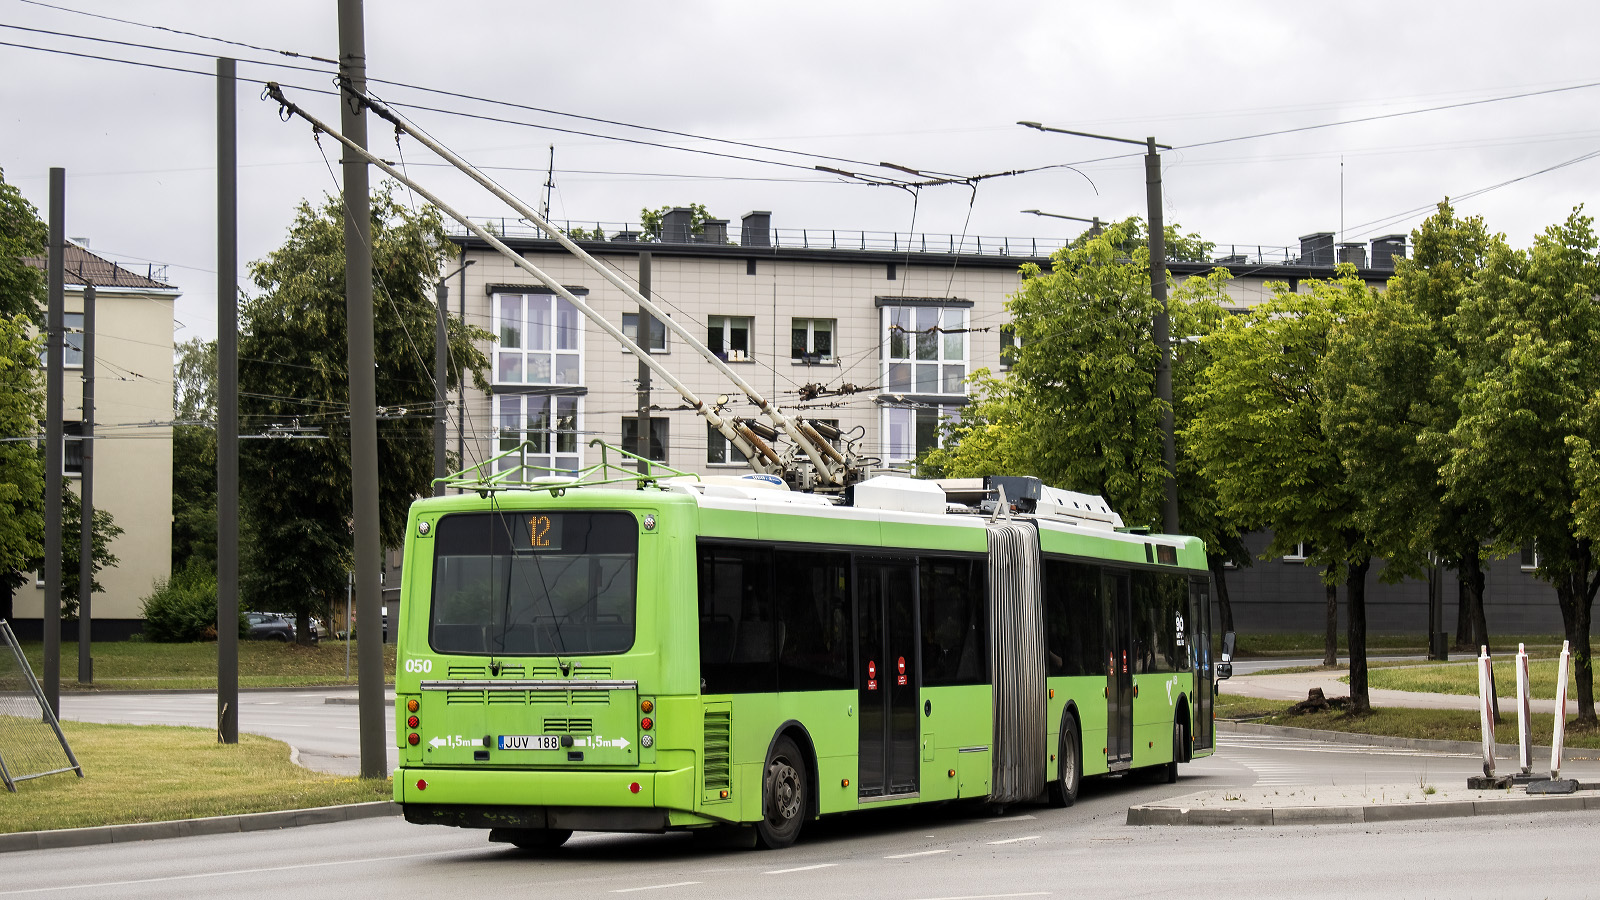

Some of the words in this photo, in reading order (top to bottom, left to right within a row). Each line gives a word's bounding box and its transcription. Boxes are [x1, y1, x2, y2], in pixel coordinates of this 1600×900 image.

[529, 516, 550, 546] 12
[405, 659, 432, 673] 050
[446, 735, 471, 749] 1,5m
[505, 737, 529, 748] JUV
[538, 737, 557, 748] 188
[586, 735, 611, 749] 1,5m
